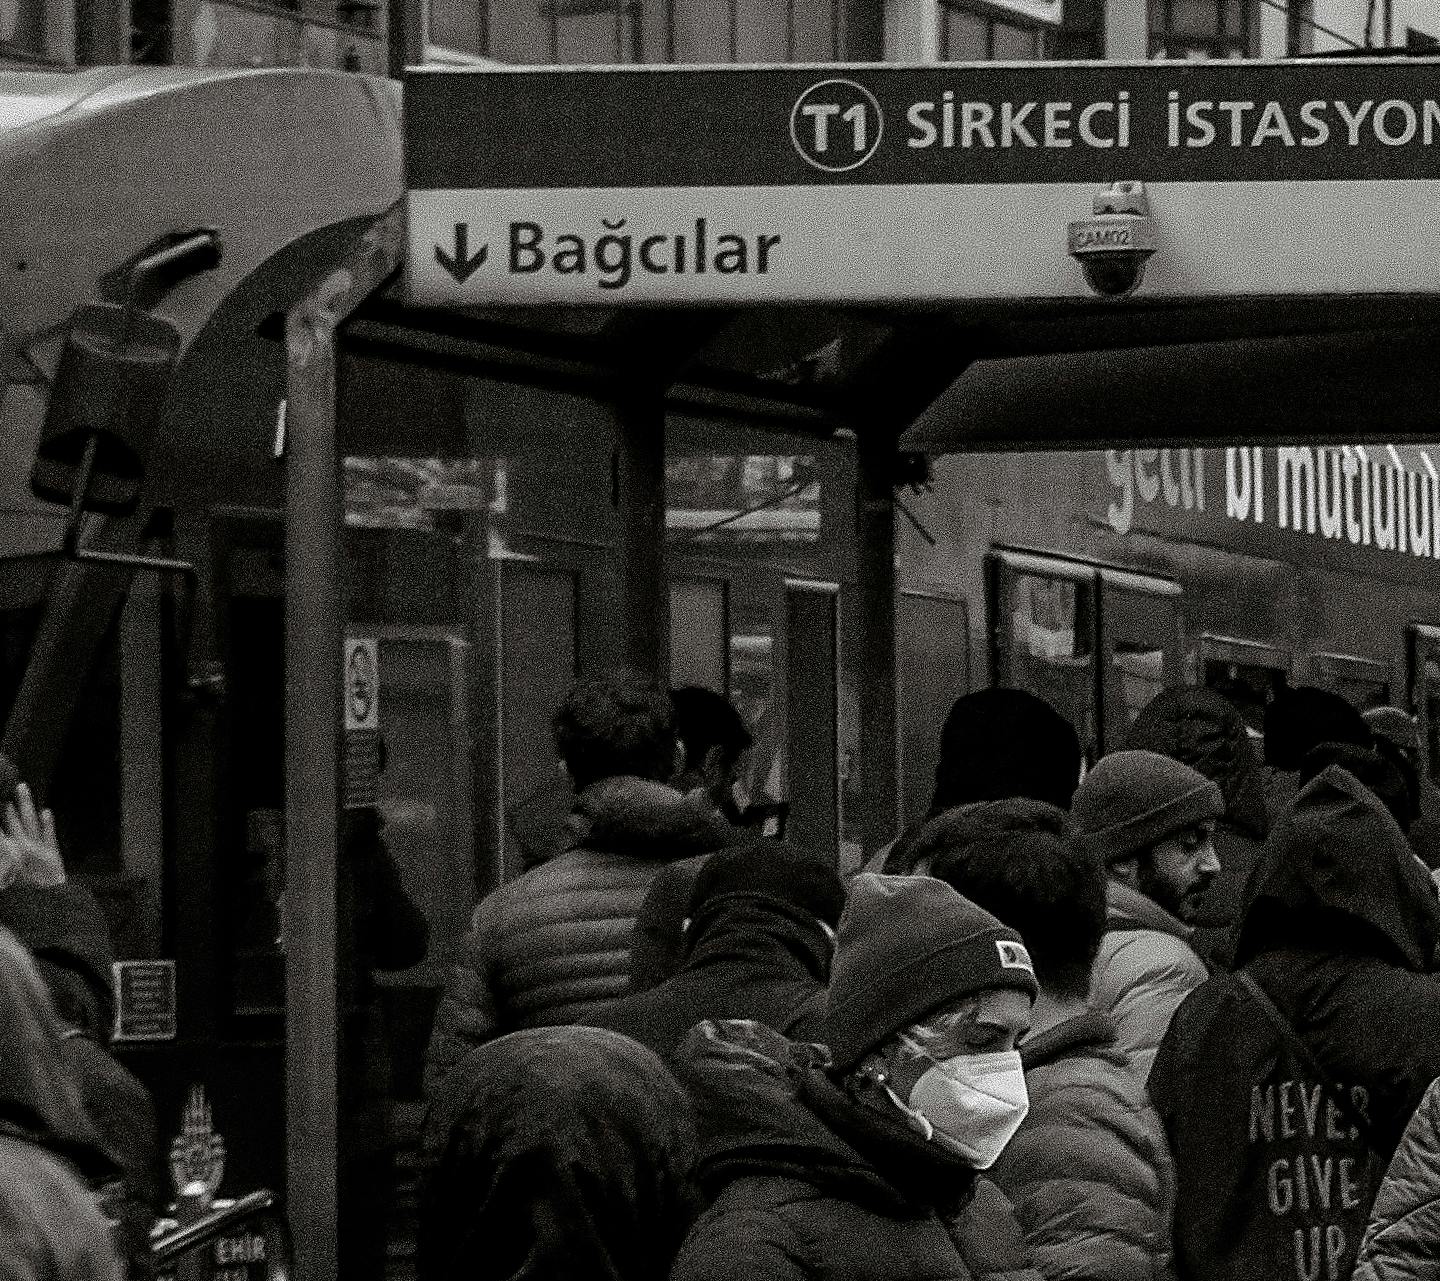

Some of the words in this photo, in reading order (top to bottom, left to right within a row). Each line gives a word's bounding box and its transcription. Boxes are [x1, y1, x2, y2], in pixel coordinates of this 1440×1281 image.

[803, 103, 868, 153] T1
[907, 89, 1130, 150] SİRKECİ
[508, 216, 782, 289] Bağcılar
[1267, 1155, 1361, 1217] GIVE
